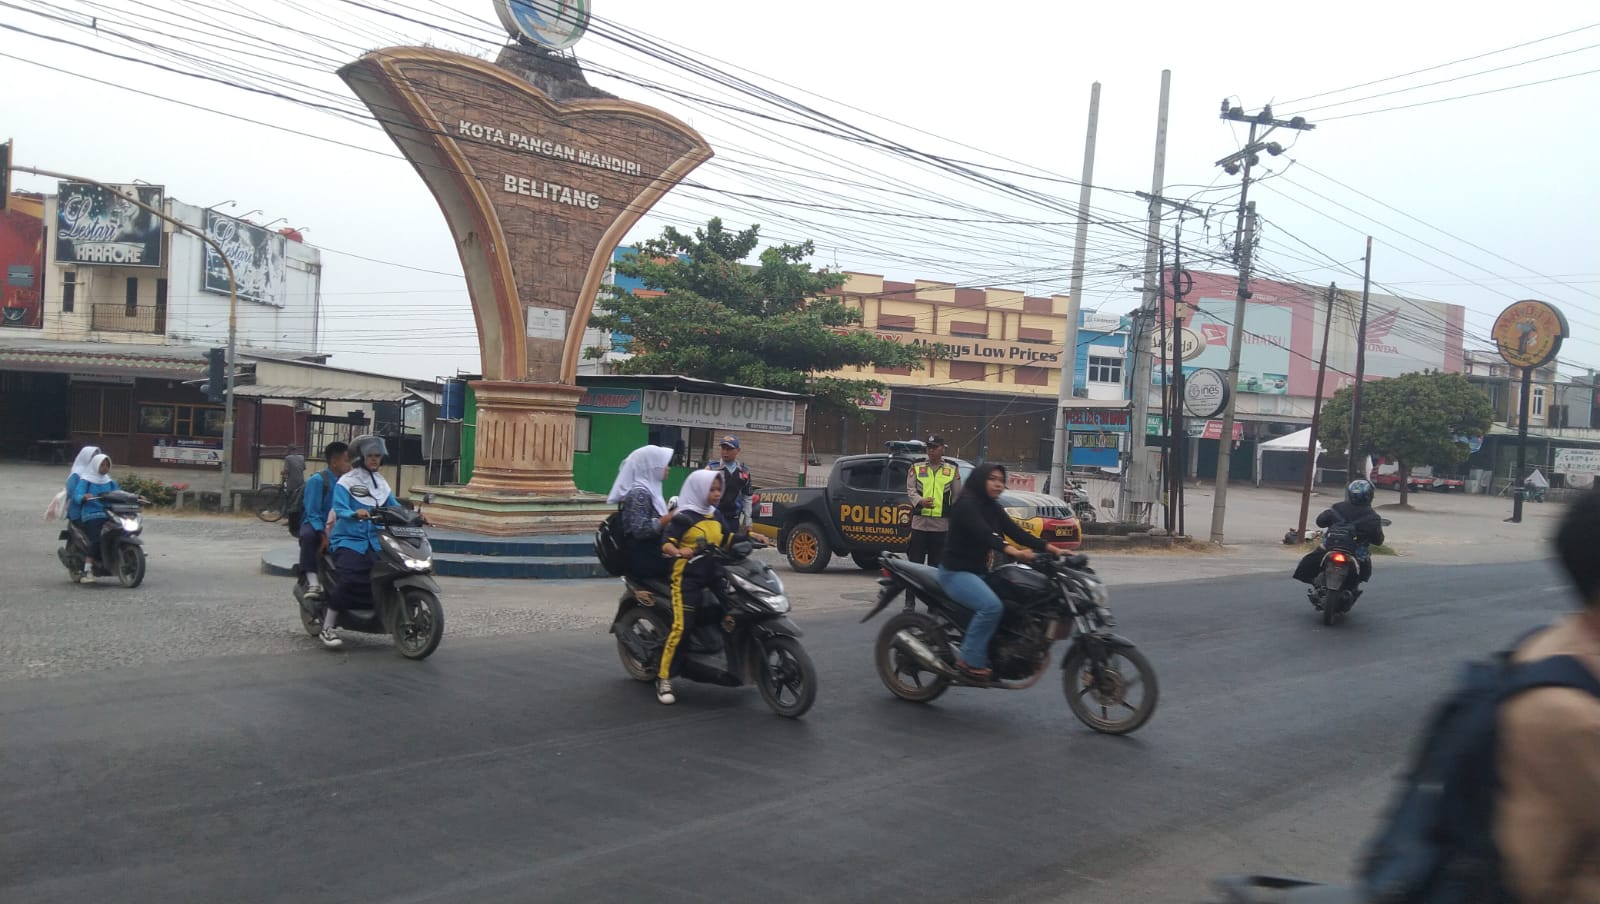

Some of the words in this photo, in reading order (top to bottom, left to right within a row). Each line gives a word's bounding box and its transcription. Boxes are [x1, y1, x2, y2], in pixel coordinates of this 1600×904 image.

[459, 119, 505, 145] KOTA
[509, 132, 575, 161] PANGAN
[578, 149, 641, 176] MANDIRI
[504, 174, 600, 210] BELITANG
[59, 195, 118, 240] Lestari
[76, 245, 142, 263] KARAOKE
[911, 337, 970, 358] Alays
[974, 344, 1006, 359] Low
[1009, 346, 1058, 362] Prices
[1242, 333, 1286, 346] AIHATSU
[1365, 343, 1399, 354] ONDA
[646, 391, 669, 412] JO
[678, 393, 722, 416] HALU
[731, 397, 793, 422] COFFEE
[760, 492, 799, 503] PATROLI
[840, 504, 898, 525] POLISI
[865, 526, 894, 535] BELITANG
